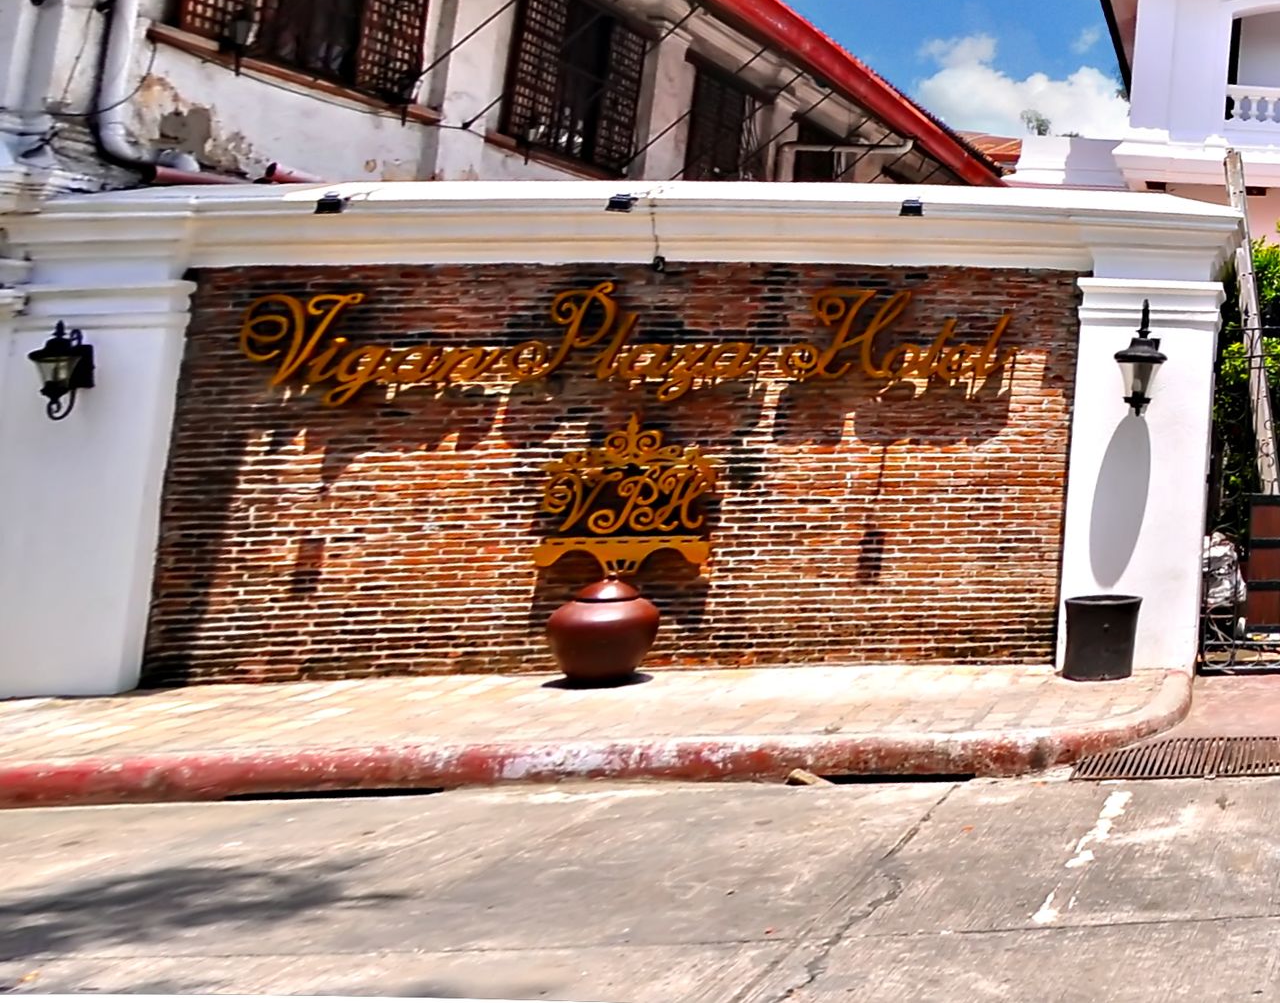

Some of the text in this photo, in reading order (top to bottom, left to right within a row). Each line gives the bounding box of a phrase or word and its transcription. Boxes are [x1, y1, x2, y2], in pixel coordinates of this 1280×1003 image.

[239, 281, 1019, 407] Vigan Plaza Hotel
